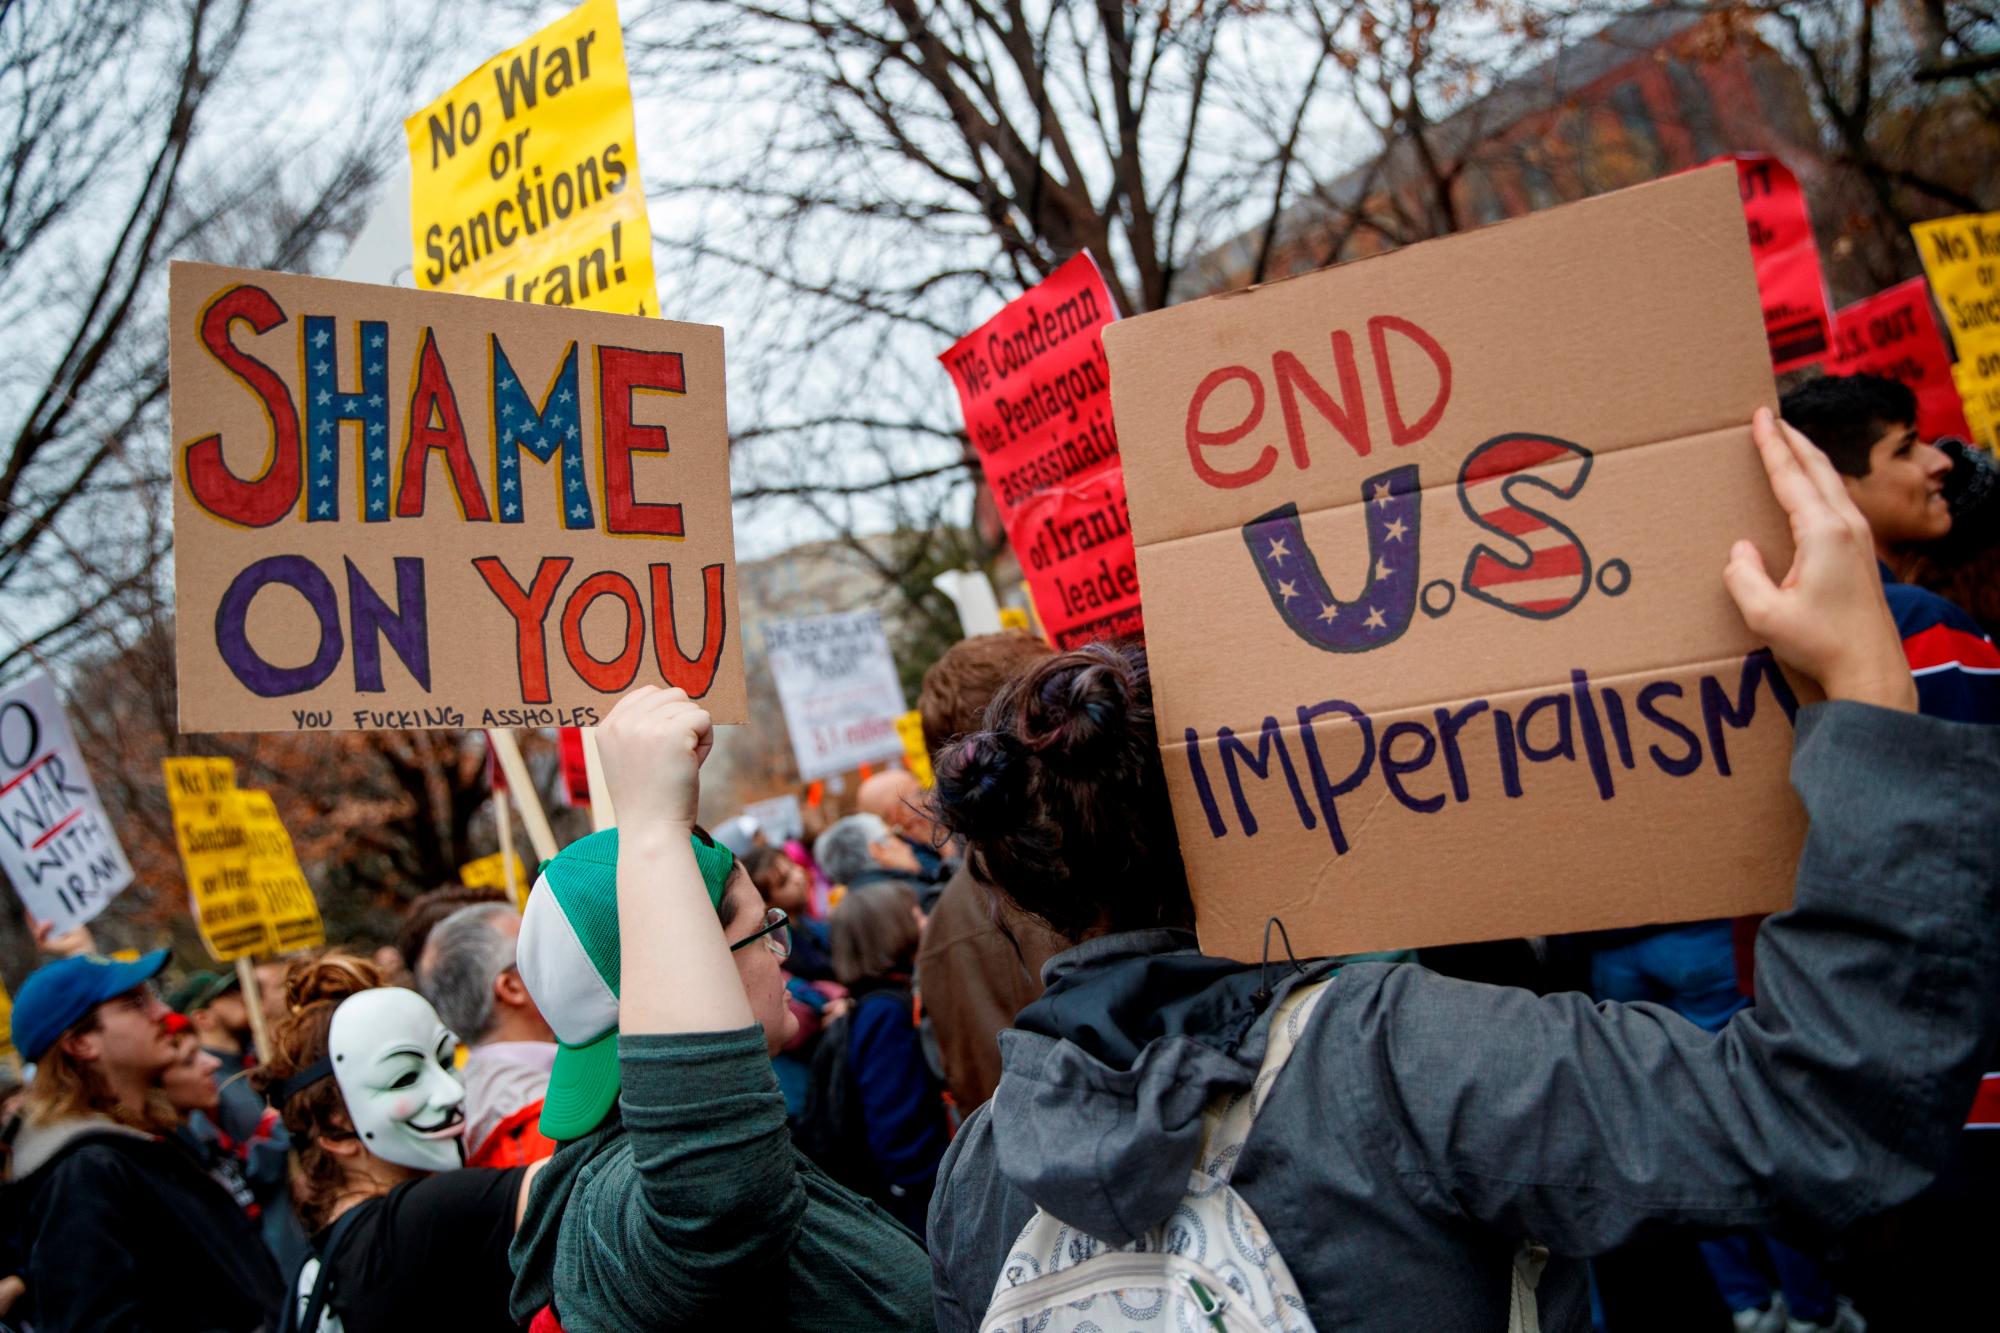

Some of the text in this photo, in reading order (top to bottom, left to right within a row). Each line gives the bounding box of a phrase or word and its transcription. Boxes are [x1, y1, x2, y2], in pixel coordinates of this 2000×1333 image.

[427, 30, 596, 171] No War
[490, 127, 530, 181] or
[425, 143, 627, 286] Sanctions
[955, 287, 1100, 399] We Condemn
[1948, 292, 2000, 330] Sanc
[179, 283, 687, 541] SHAME
[976, 421, 1005, 454] the
[1029, 530, 1053, 571] of
[1241, 432, 1632, 653] U.S.
[1055, 559, 1140, 618] leade
[215, 553, 726, 704] ON YOU
[292, 706, 600, 729] YOU FUCKING ASSHOLES
[0, 754, 88, 850] WAR
[25, 812, 101, 886] WITH
[56, 848, 121, 915] IRAN
